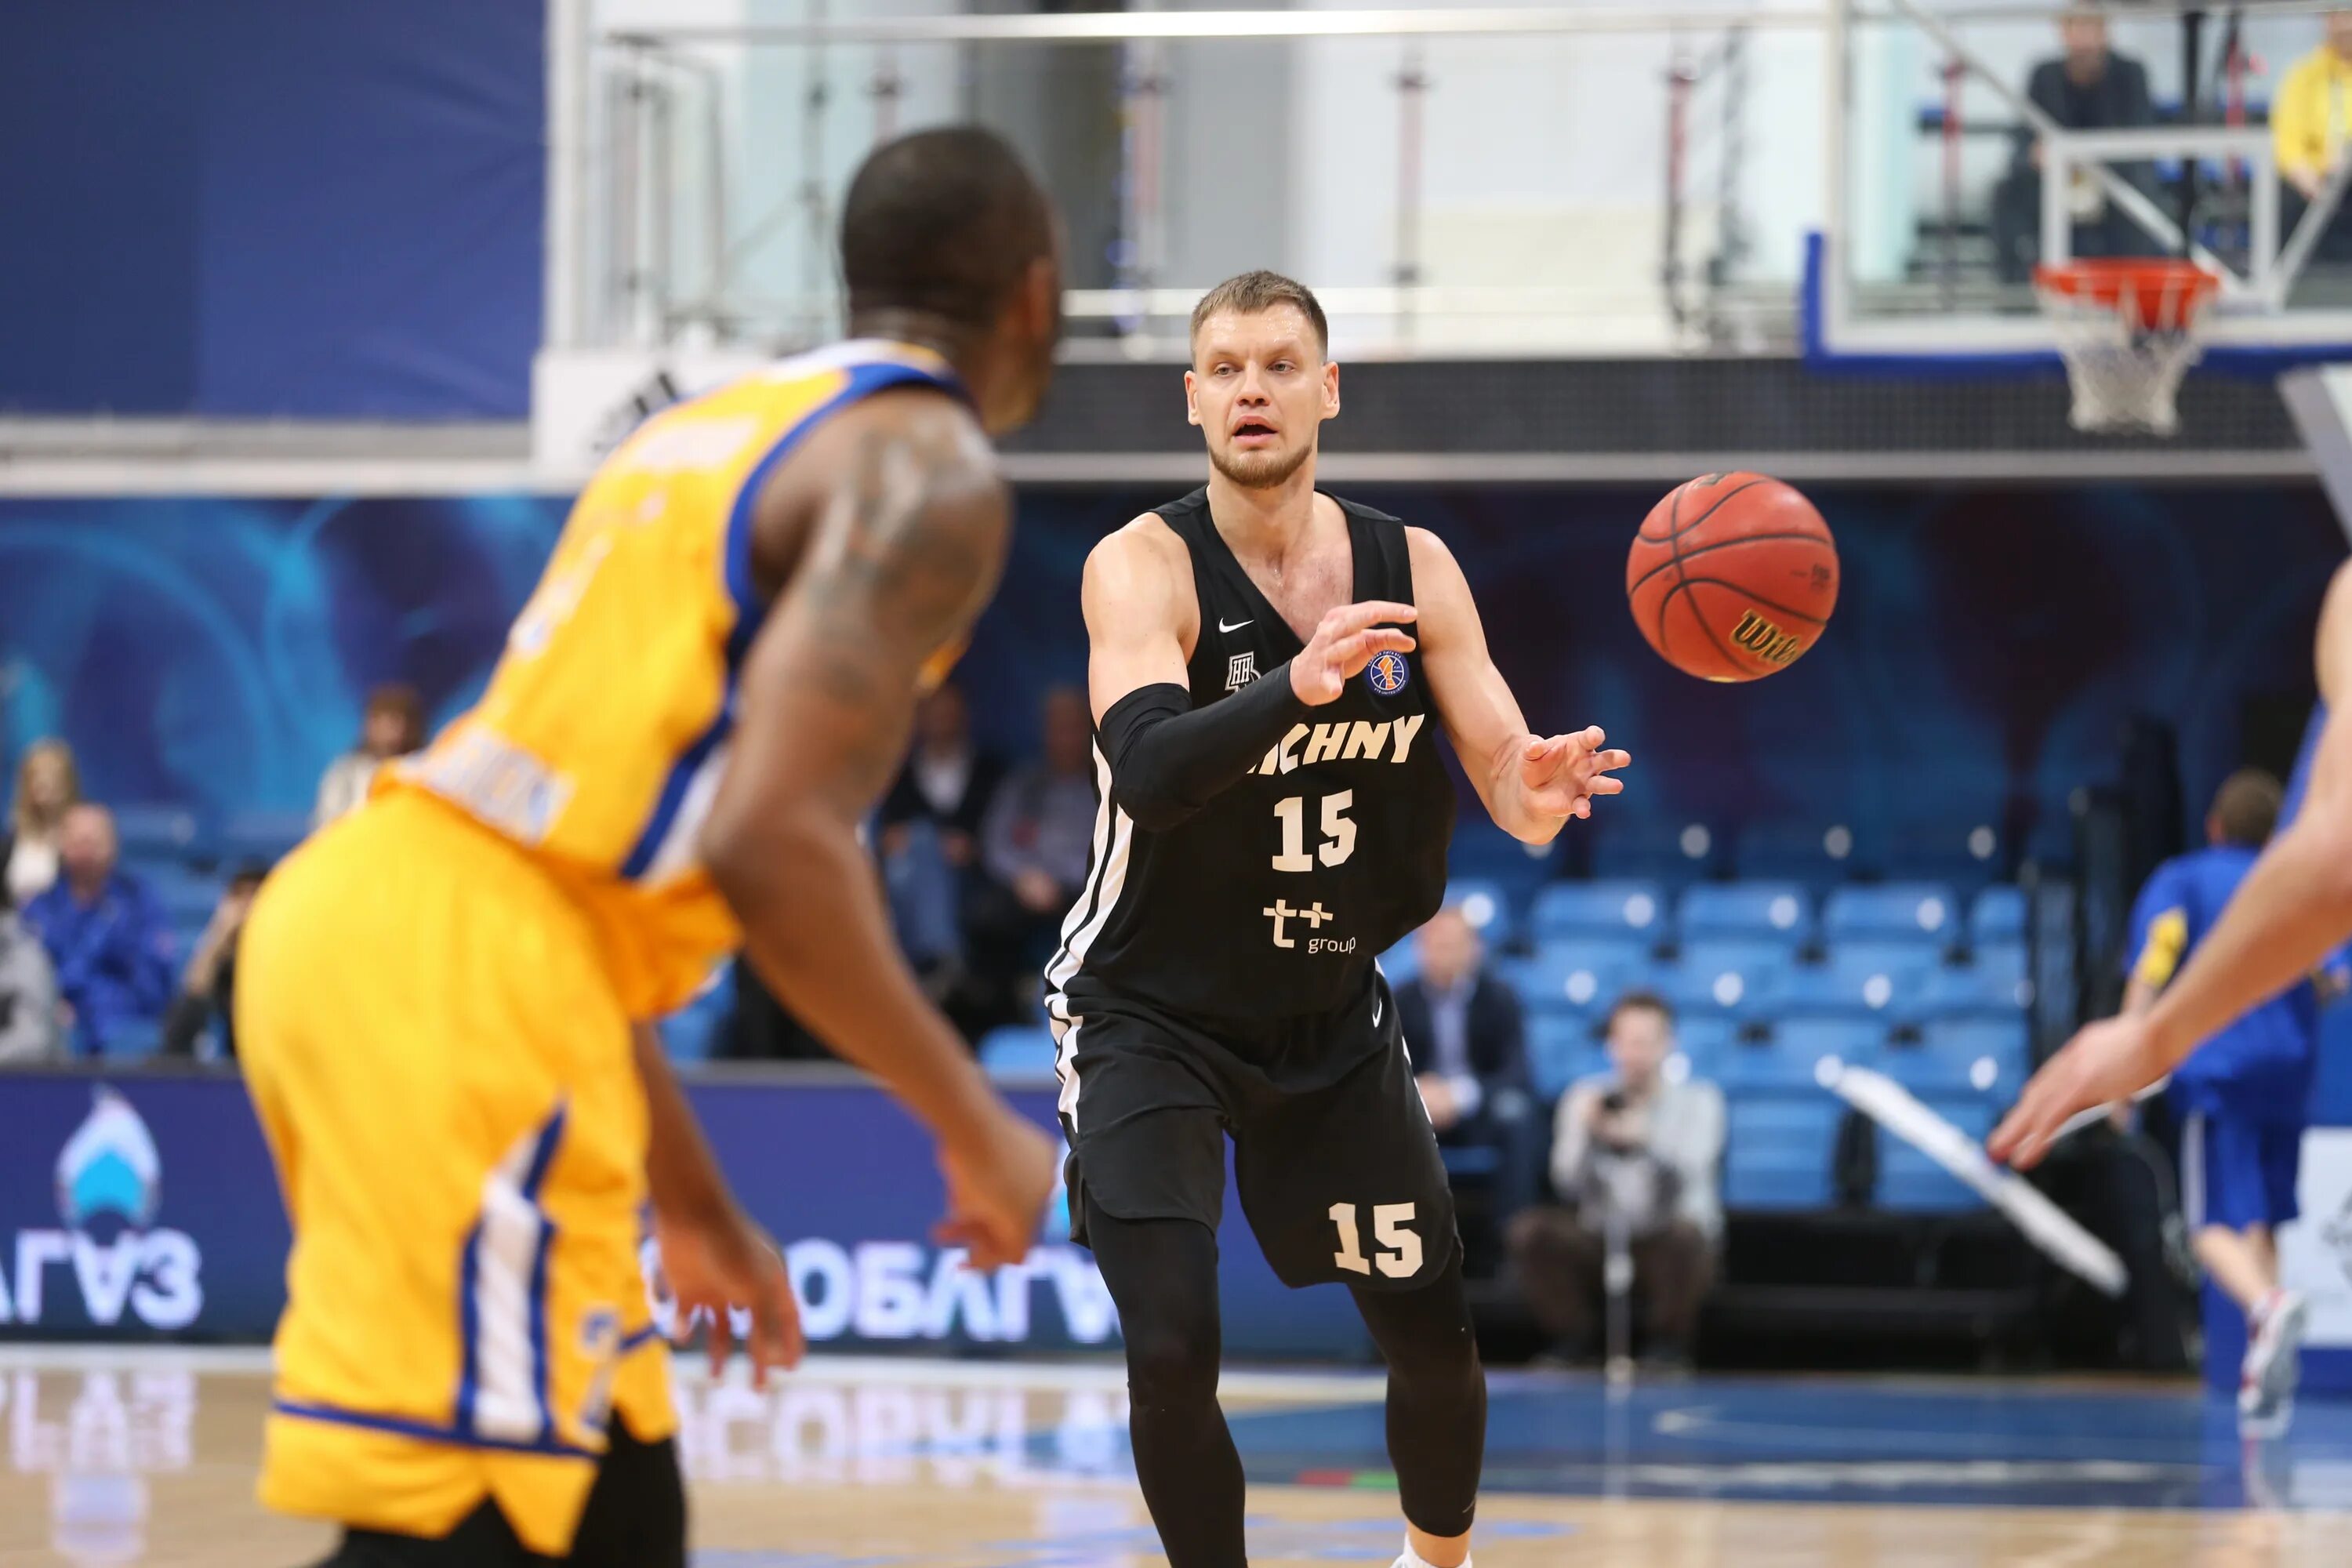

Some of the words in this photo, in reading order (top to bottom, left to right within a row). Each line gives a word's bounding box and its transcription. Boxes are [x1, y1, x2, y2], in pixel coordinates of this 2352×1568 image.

[1272, 788, 1357, 872] 15
[1308, 937, 1356, 954] group
[1329, 1202, 1423, 1278] 15
